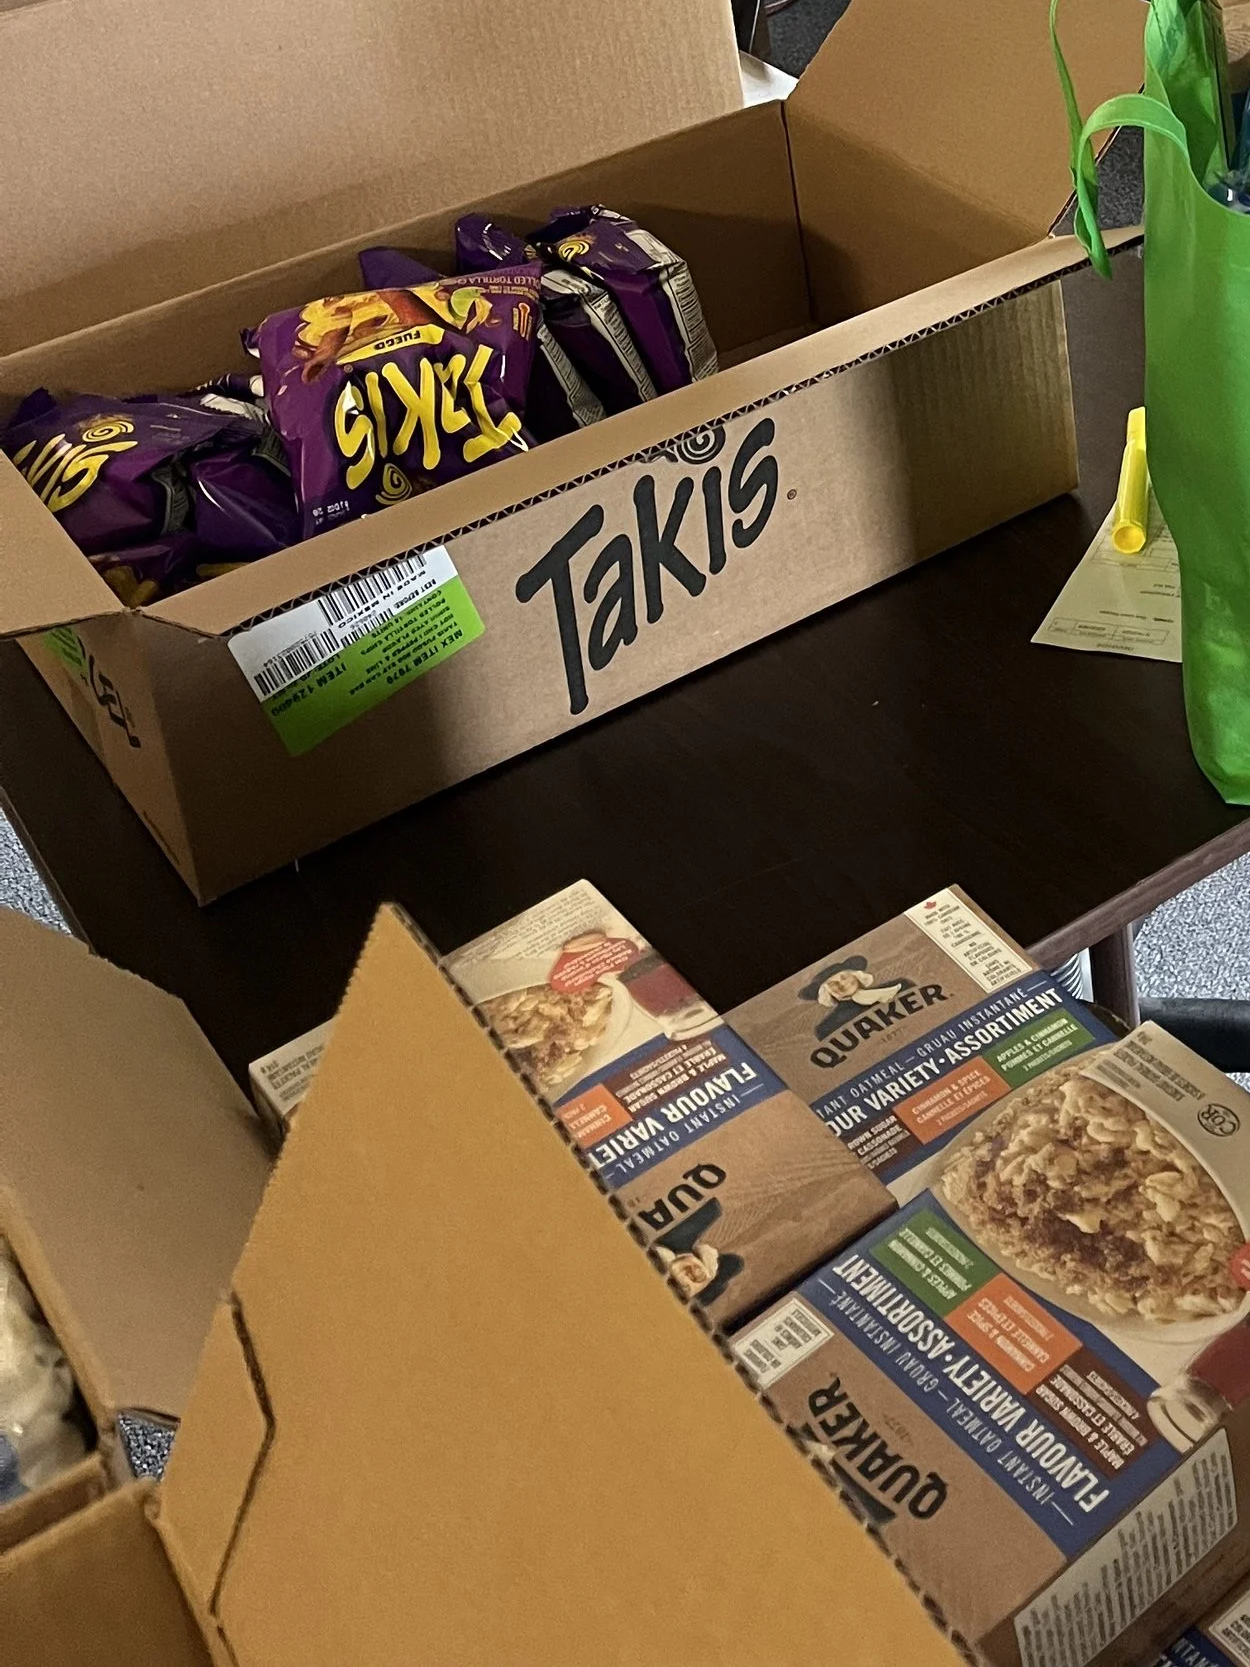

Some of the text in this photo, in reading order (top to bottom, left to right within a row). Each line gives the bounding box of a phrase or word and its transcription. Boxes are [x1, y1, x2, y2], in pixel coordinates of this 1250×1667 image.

[372, 329, 421, 351] FUEGO
[335, 344, 528, 491] Takis
[516, 417, 778, 715] Takis
[337, 599, 379, 629] MEXICO
[382, 590, 394, 600] IN
[382, 615, 418, 642] TORTILLA
[384, 628, 464, 685] MEX ITEM 7070
[314, 661, 348, 689] ITEM
[810, 983, 944, 1071] QUAKER
[815, 984, 1029, 1120] TANT OATMEAL GRUAU INSTANTANÉ
[863, 1055, 941, 1116] VARIETY
[943, 984, 1064, 1066] ASSORTIMENT
[568, 1103, 607, 1130] CANNELL
[660, 1058, 756, 1125] FLAVOUR
[1199, 1102, 1238, 1137] COR
[574, 1113, 611, 1139] CINNAM
[586, 1112, 664, 1170] VARIET
[614, 1092, 740, 1175] INSTANT OATMEAL
[870, 1114, 897, 1135] SUGAR
[637, 1162, 727, 1233] QUA
[831, 1247, 955, 1365] ASSORTIMENT
[926, 1271, 957, 1301] APPLES
[827, 1288, 901, 1357] INSTANTANÉ
[966, 1307, 993, 1333] SPICE
[894, 1348, 940, 1394] GRUAU
[941, 1349, 1028, 1433] VARIETY
[1034, 1381, 1064, 1411] SUGAR
[1048, 1372, 1096, 1419] CASSONADE
[944, 1396, 1003, 1454] OATMEAL
[1058, 1404, 1092, 1437] BROWN
[807, 1378, 948, 1521] QUAKER
[998, 1447, 1056, 1505] INSTANT
[1012, 1417, 1111, 1513] FLAVOUR
[1094, 1438, 1125, 1469] MAPLE
